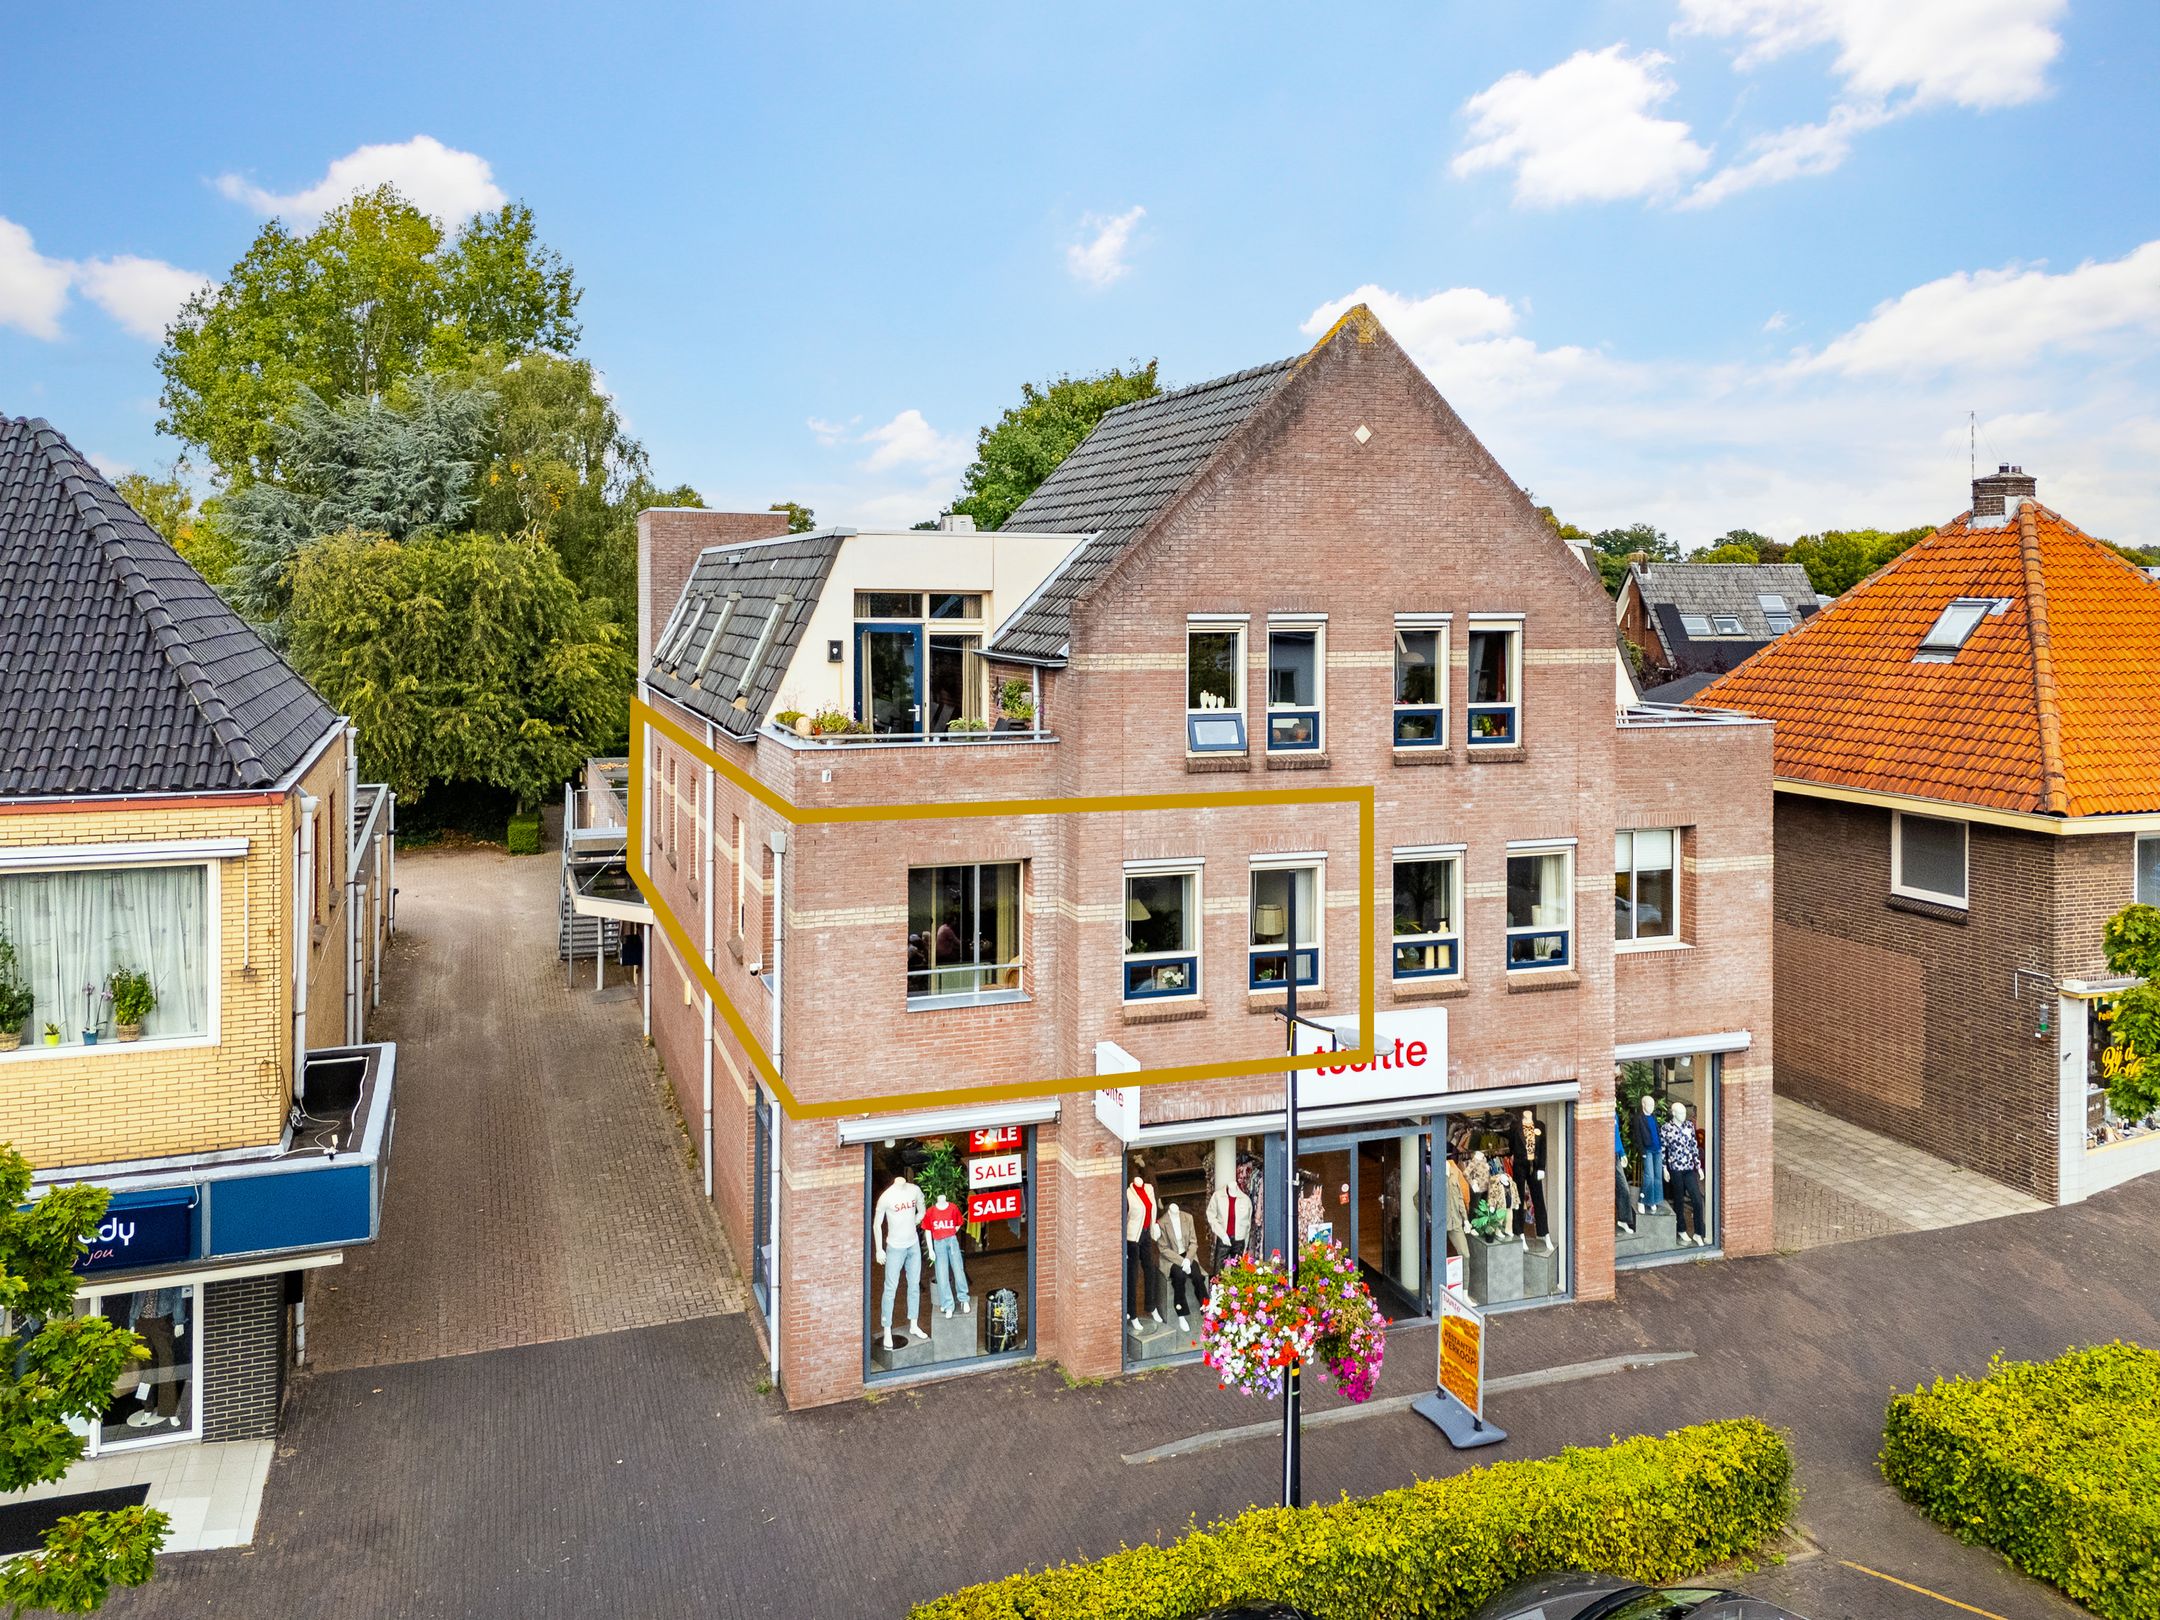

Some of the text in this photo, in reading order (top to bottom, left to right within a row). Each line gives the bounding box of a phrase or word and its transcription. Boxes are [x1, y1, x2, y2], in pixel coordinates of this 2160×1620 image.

[975, 1162, 1017, 1180] SALE
[894, 1199, 916, 1213] SALE
[973, 1196, 1017, 1217] SALE
[933, 1219, 955, 1230] SALE
